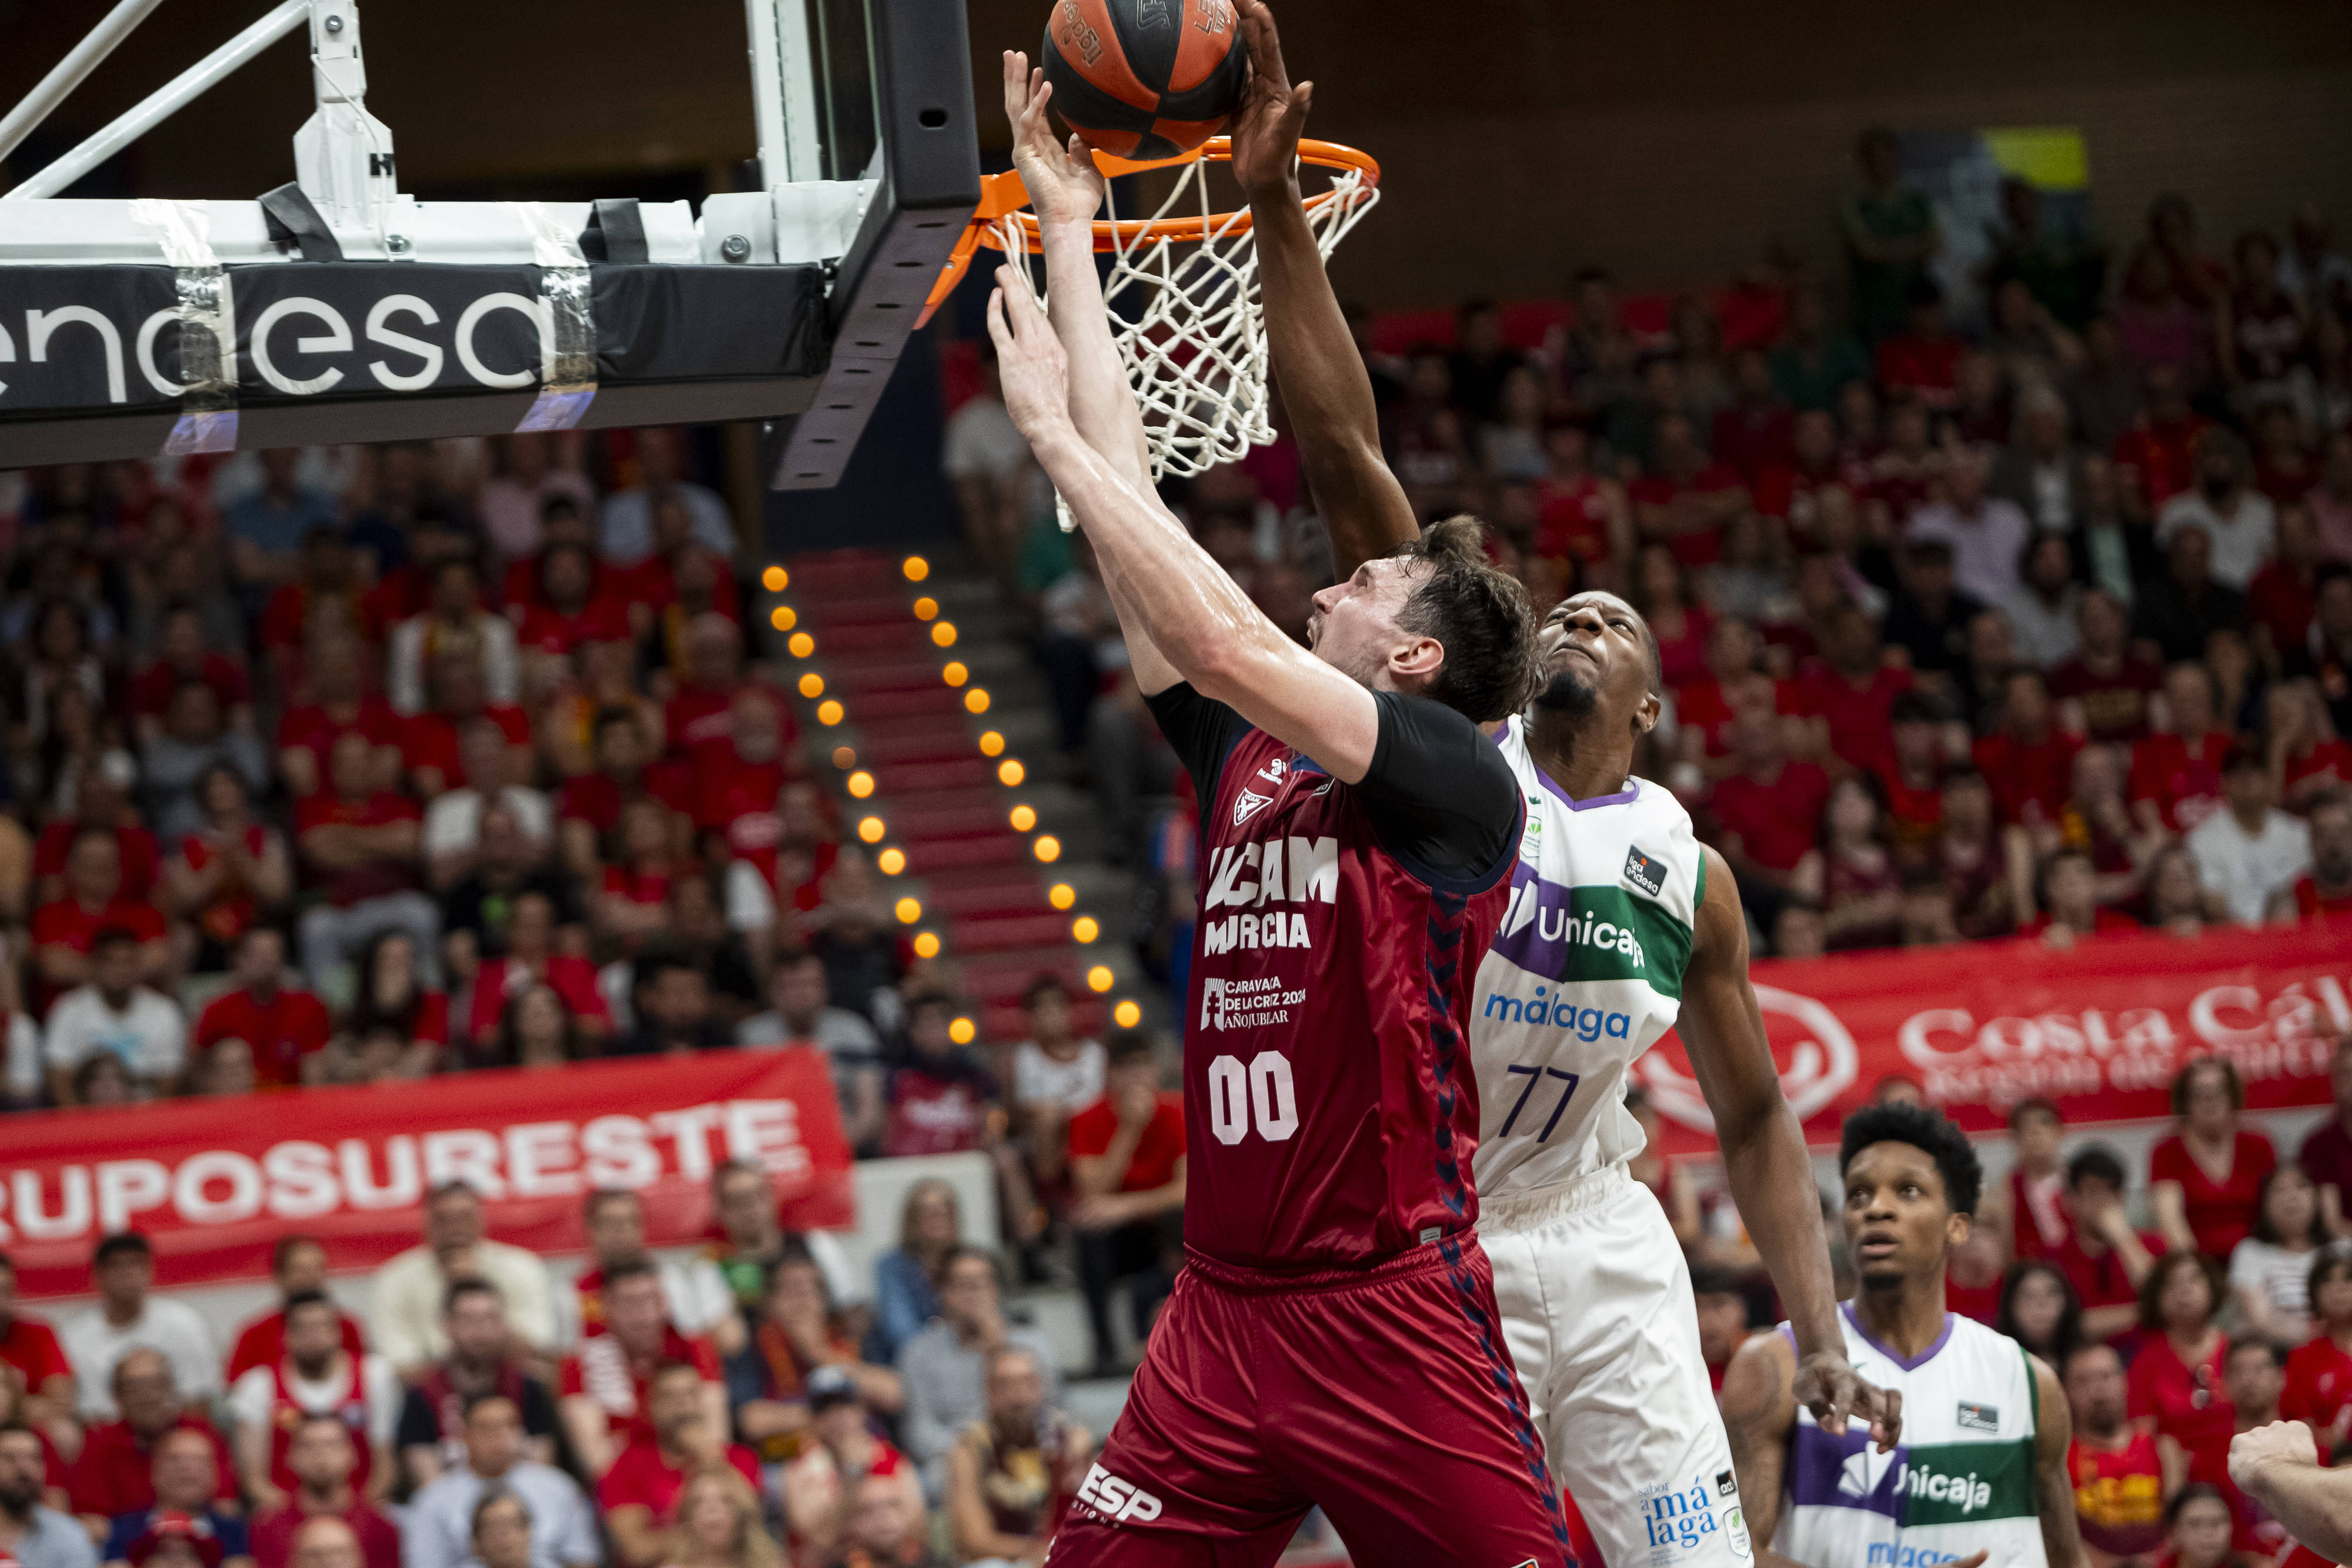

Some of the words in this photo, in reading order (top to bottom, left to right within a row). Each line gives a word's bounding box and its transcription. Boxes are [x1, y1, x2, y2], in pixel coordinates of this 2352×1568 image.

[0, 272, 556, 403] ndesa
[1205, 836, 1338, 912] UCAM
[1626, 866, 1659, 894] endesa
[1629, 855, 1644, 874] liga
[1205, 911, 1311, 958] MURCIA
[1225, 975, 1282, 994] CARAVACA
[1225, 998, 1241, 1011] DE
[1242, 997, 1252, 1010] LA
[1282, 988, 1306, 1005] 2024
[1224, 1012, 1248, 1028] AÑO
[1898, 1007, 2177, 1071] Costa
[1208, 1050, 1299, 1145] 00
[1499, 1064, 1580, 1143] 77
[0, 1097, 811, 1241] UPOSURESTE
[1077, 1462, 1162, 1522] ESP
[1638, 1481, 1671, 1497] sabor
[1645, 1510, 1719, 1548] laga
